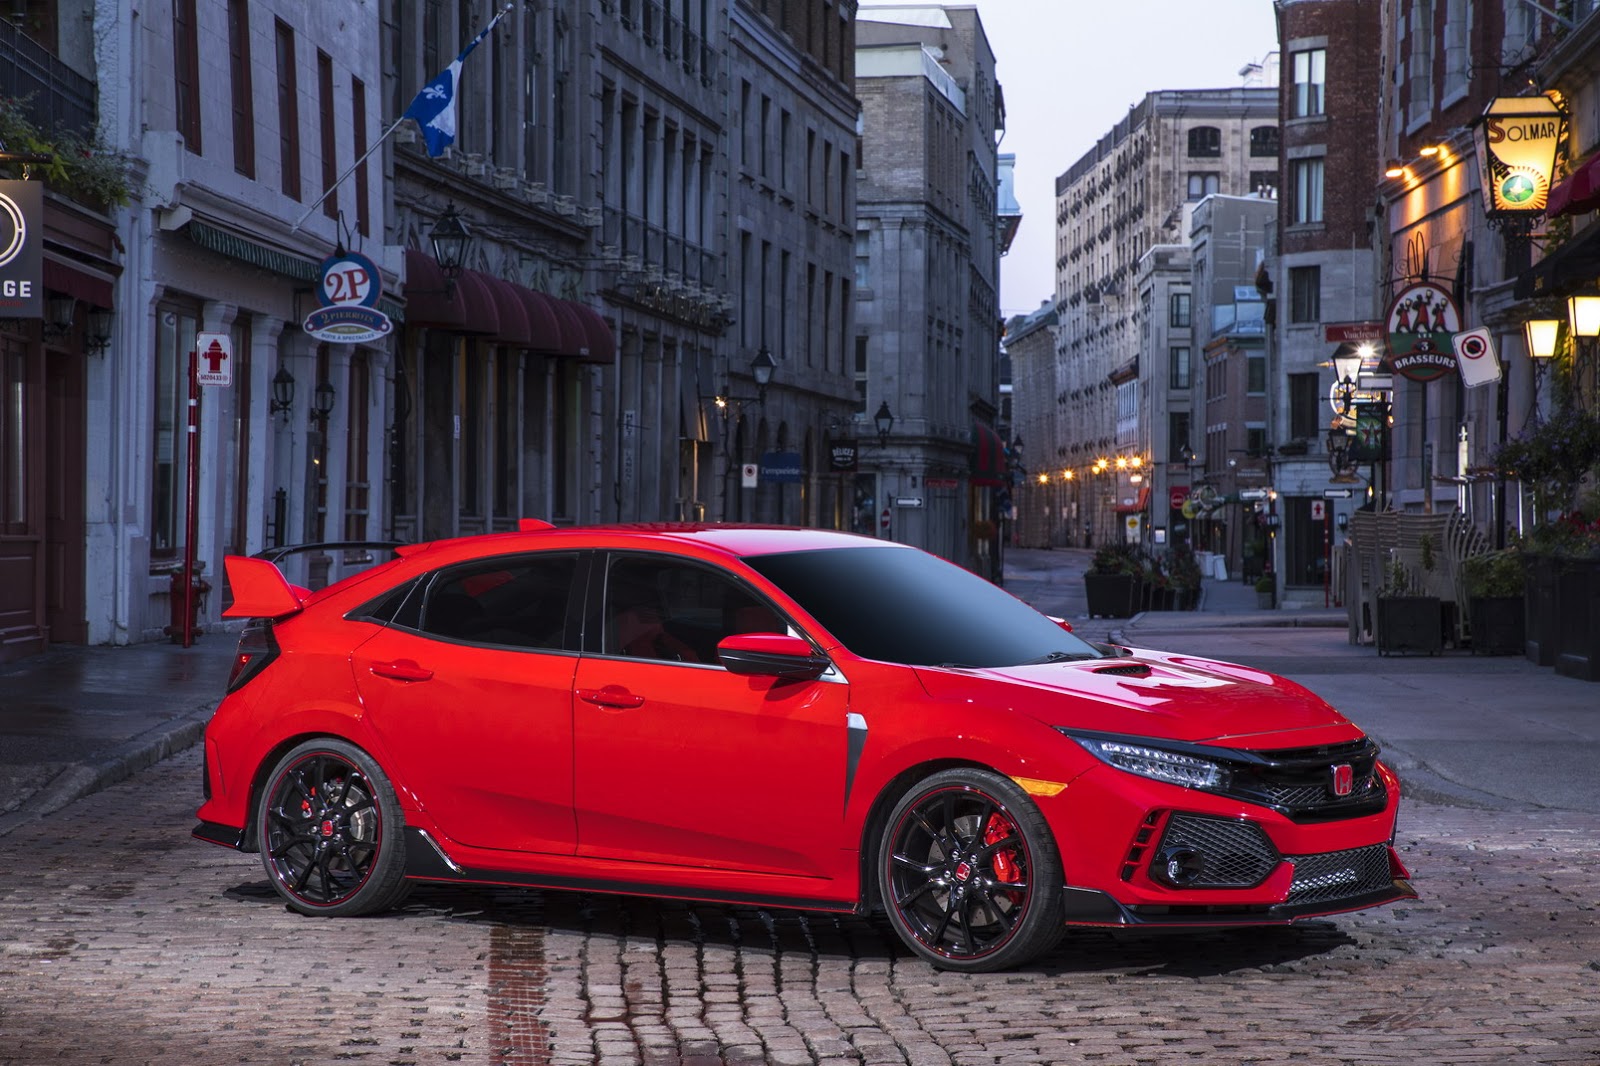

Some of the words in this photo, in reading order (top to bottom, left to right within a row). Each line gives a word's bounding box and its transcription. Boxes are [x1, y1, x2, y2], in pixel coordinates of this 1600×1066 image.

[1488, 118, 1556, 143] SOLMAR
[325, 268, 369, 303] 2P
[321, 312, 330, 324] 2
[1421, 342, 1429, 352] 3
[1394, 355, 1457, 369] BRASSEURS
